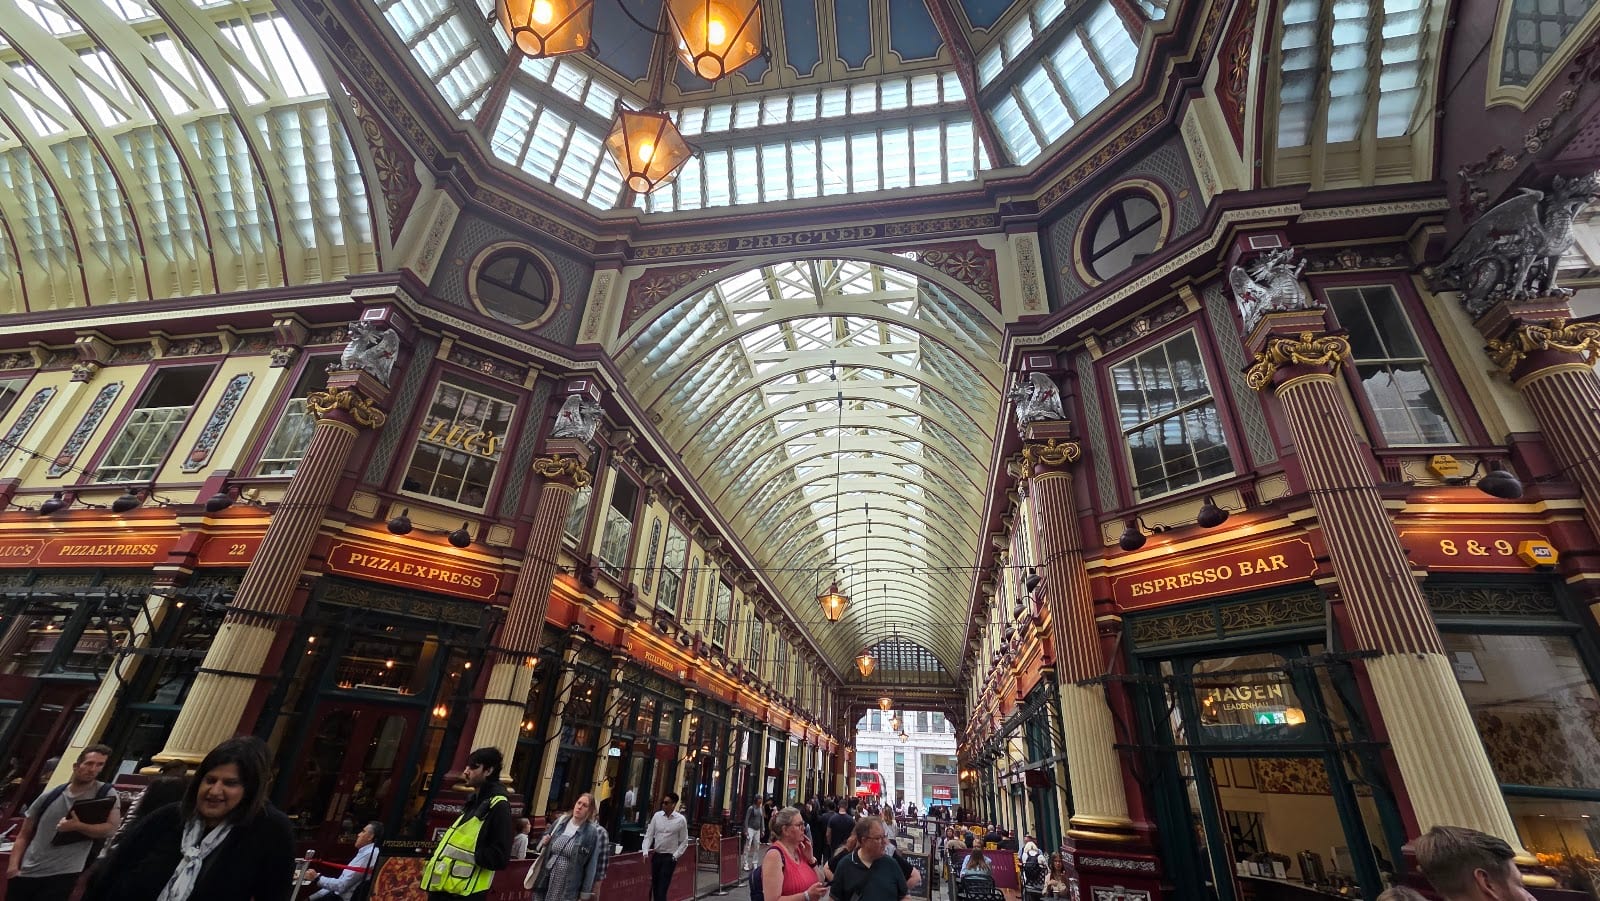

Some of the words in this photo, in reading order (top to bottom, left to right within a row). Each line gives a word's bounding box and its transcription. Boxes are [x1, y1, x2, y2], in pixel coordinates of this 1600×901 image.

[736, 226, 876, 249] ERECTED
[427, 420, 501, 456] LUC'S
[58, 544, 158, 556] PIZZAEXPRESS
[228, 544, 246, 556] 22
[1440, 540, 1458, 556] 8
[1466, 540, 1490, 556] &
[1494, 540, 1513, 556] 9
[348, 552, 482, 588] PIZZAEXPRESS
[1131, 565, 1232, 597] ESPRESSO
[1238, 554, 1288, 577] BAR
[1207, 683, 1283, 702] HAGEN
